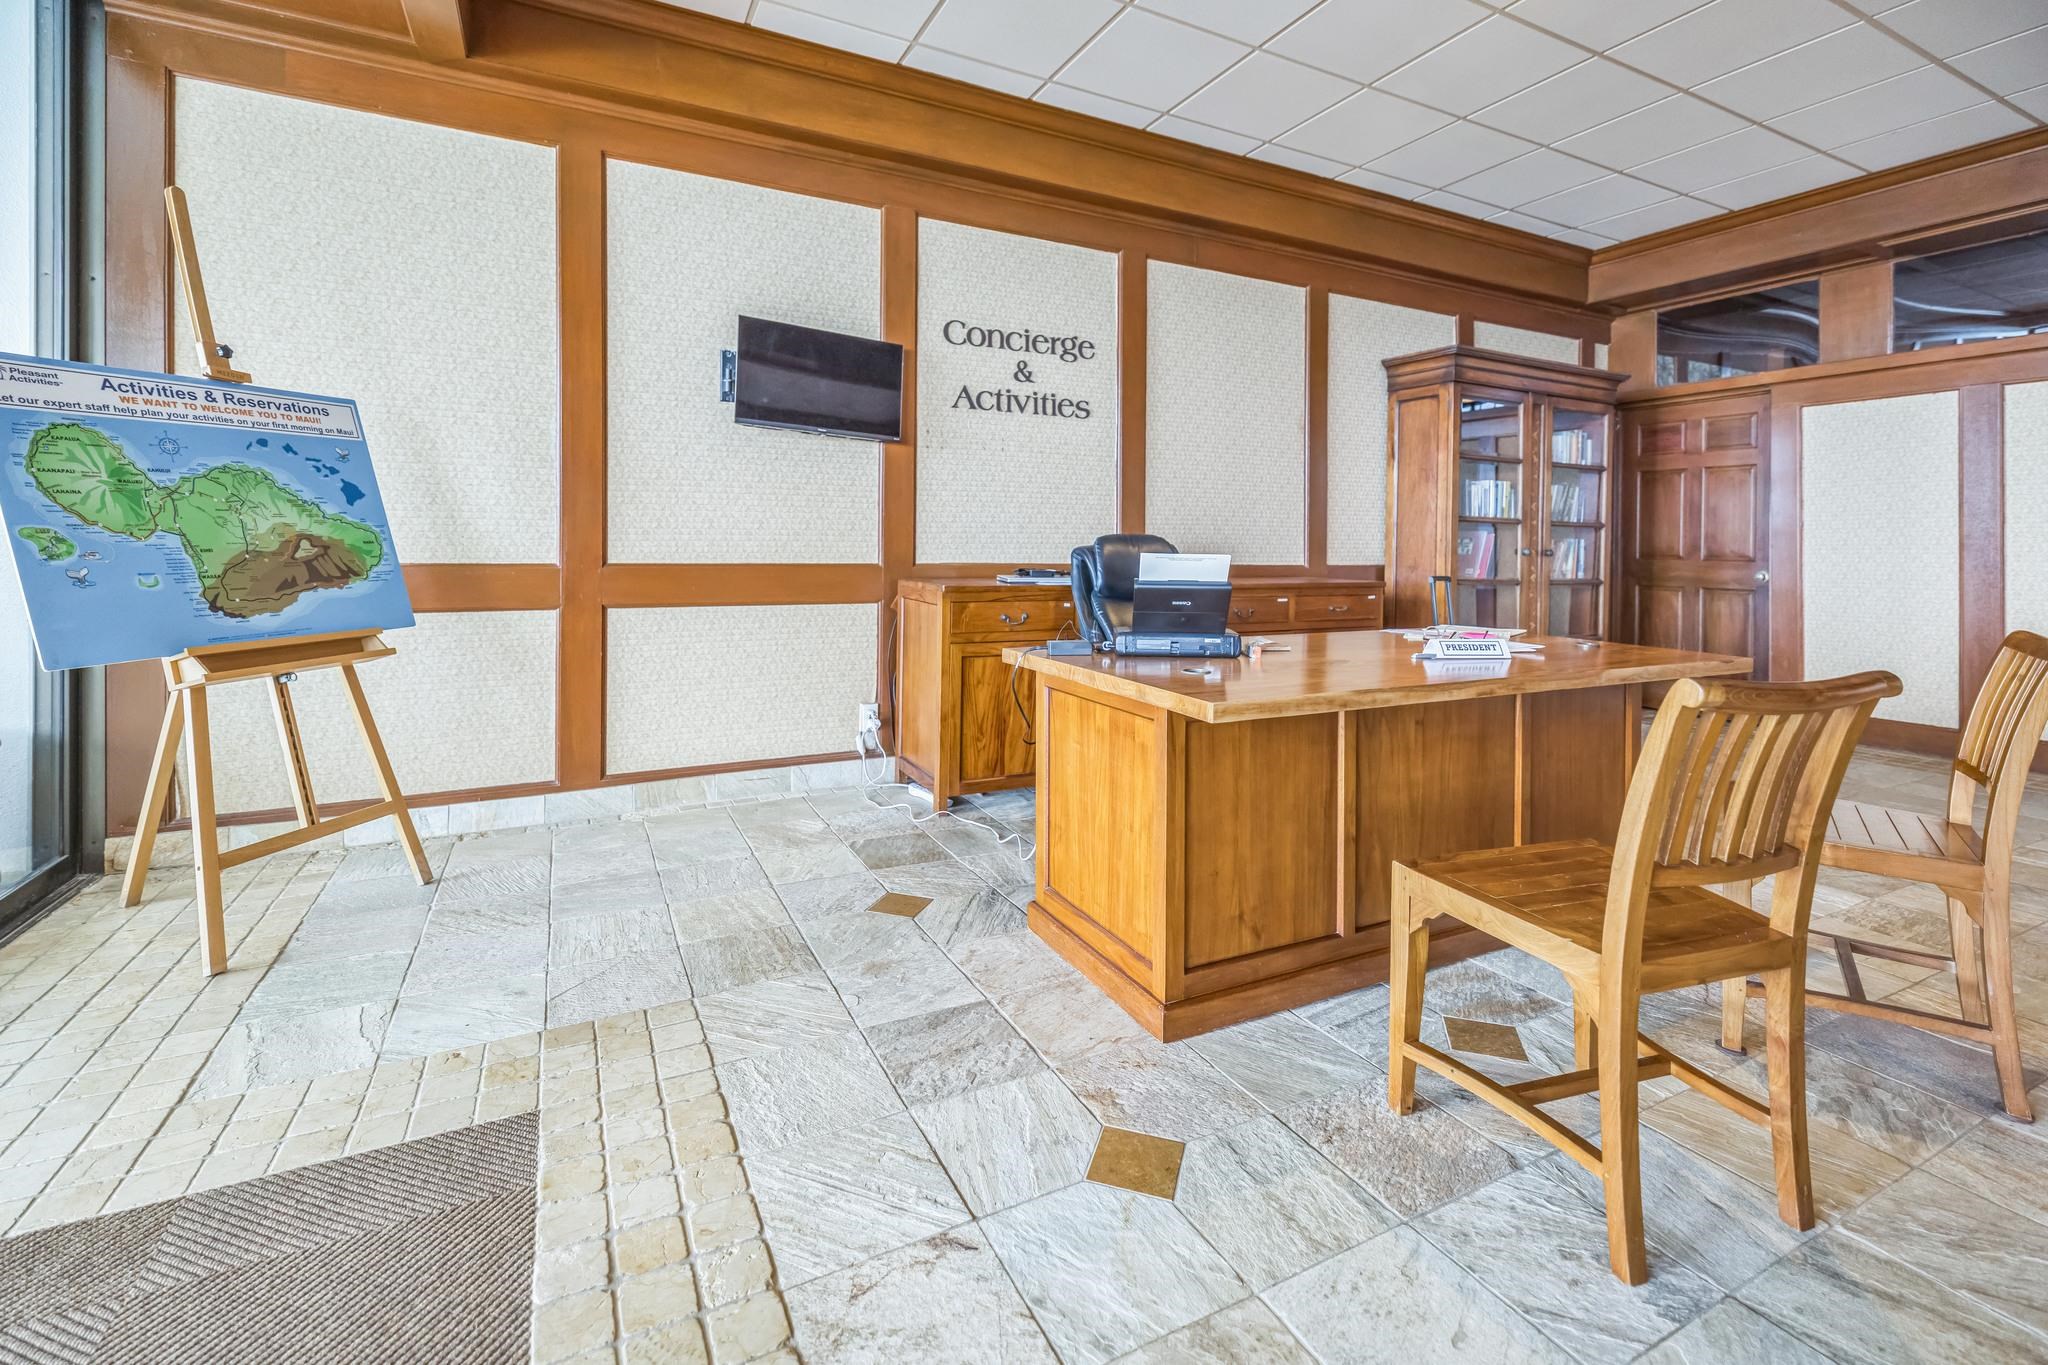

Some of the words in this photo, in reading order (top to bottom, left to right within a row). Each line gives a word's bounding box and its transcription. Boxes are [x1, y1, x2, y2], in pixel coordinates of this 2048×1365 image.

[943, 320, 1096, 363] Concierge
[9, 367, 60, 380] Pleasant
[1013, 360, 1036, 384] &
[101, 378, 198, 401] Activities
[204, 390, 219, 404] &
[223, 392, 330, 417] Reservations
[119, 395, 140, 405] WE
[142, 398, 178, 409] WANT
[182, 402, 198, 411] TO
[201, 404, 254, 417] WELCOME
[257, 410, 278, 420] YOU
[281, 413, 293, 422] TO
[295, 415, 322, 425] MAUI!
[952, 385, 1091, 419] Activities
[0, 393, 14, 403] et
[18, 396, 40, 405] our
[43, 400, 82, 410] expert
[85, 402, 110, 412] staff
[114, 404, 138, 416] help
[141, 408, 164, 418] plan
[166, 411, 190, 421] your
[192, 413, 235, 425] activities
[251, 420, 270, 429] your
[272, 421, 289, 430] first
[290, 424, 324, 435] morning
[336, 427, 355, 436] Maui
[1445, 643, 1497, 652] PRESIDENT
